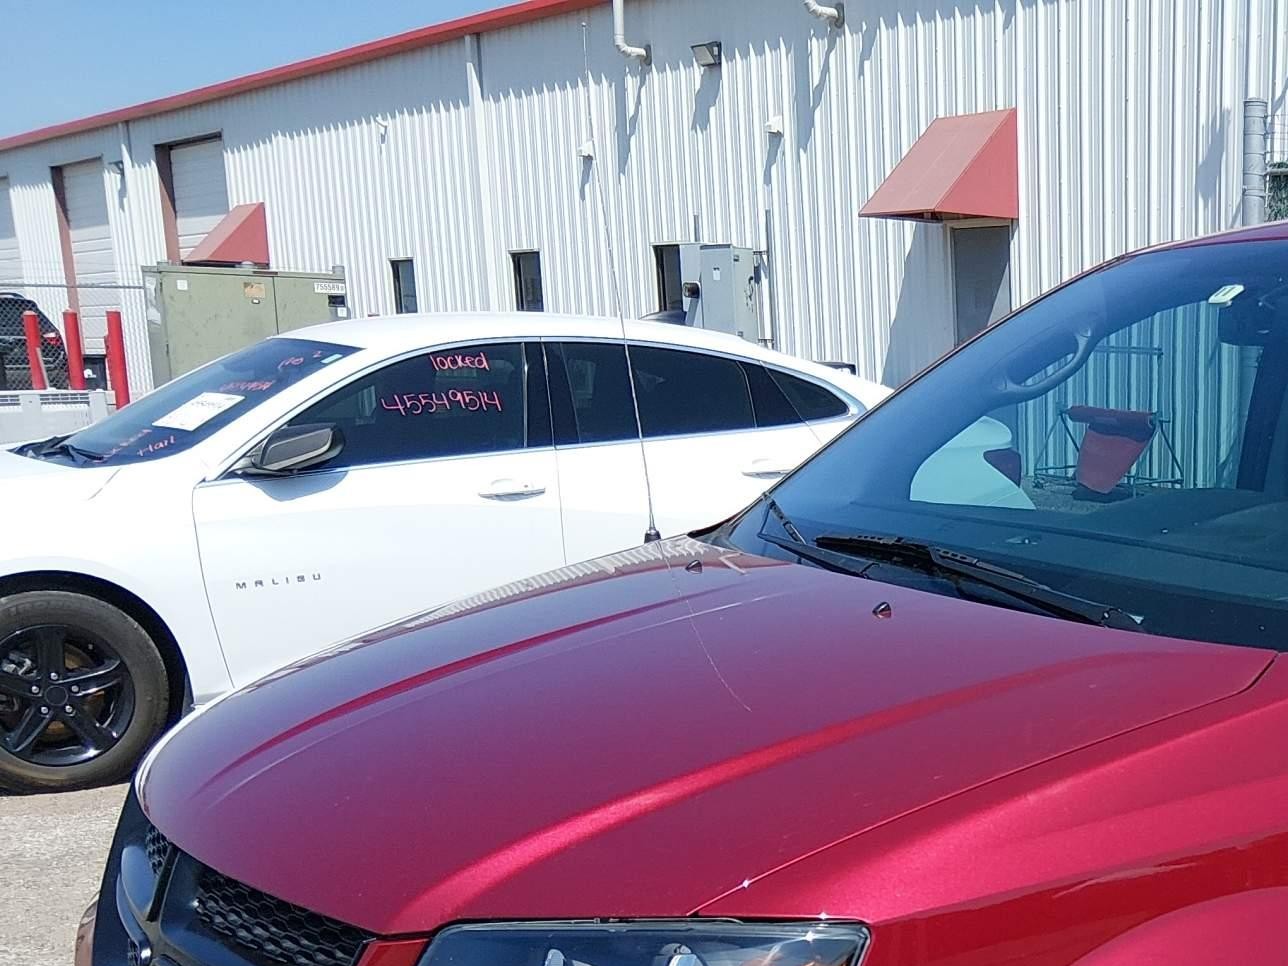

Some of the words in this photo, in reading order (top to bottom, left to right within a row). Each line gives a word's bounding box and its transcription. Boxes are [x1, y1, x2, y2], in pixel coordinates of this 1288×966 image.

[430, 352, 489, 371] locked
[381, 389, 502, 416] 45549514
[236, 573, 321, 590] MALIBU
